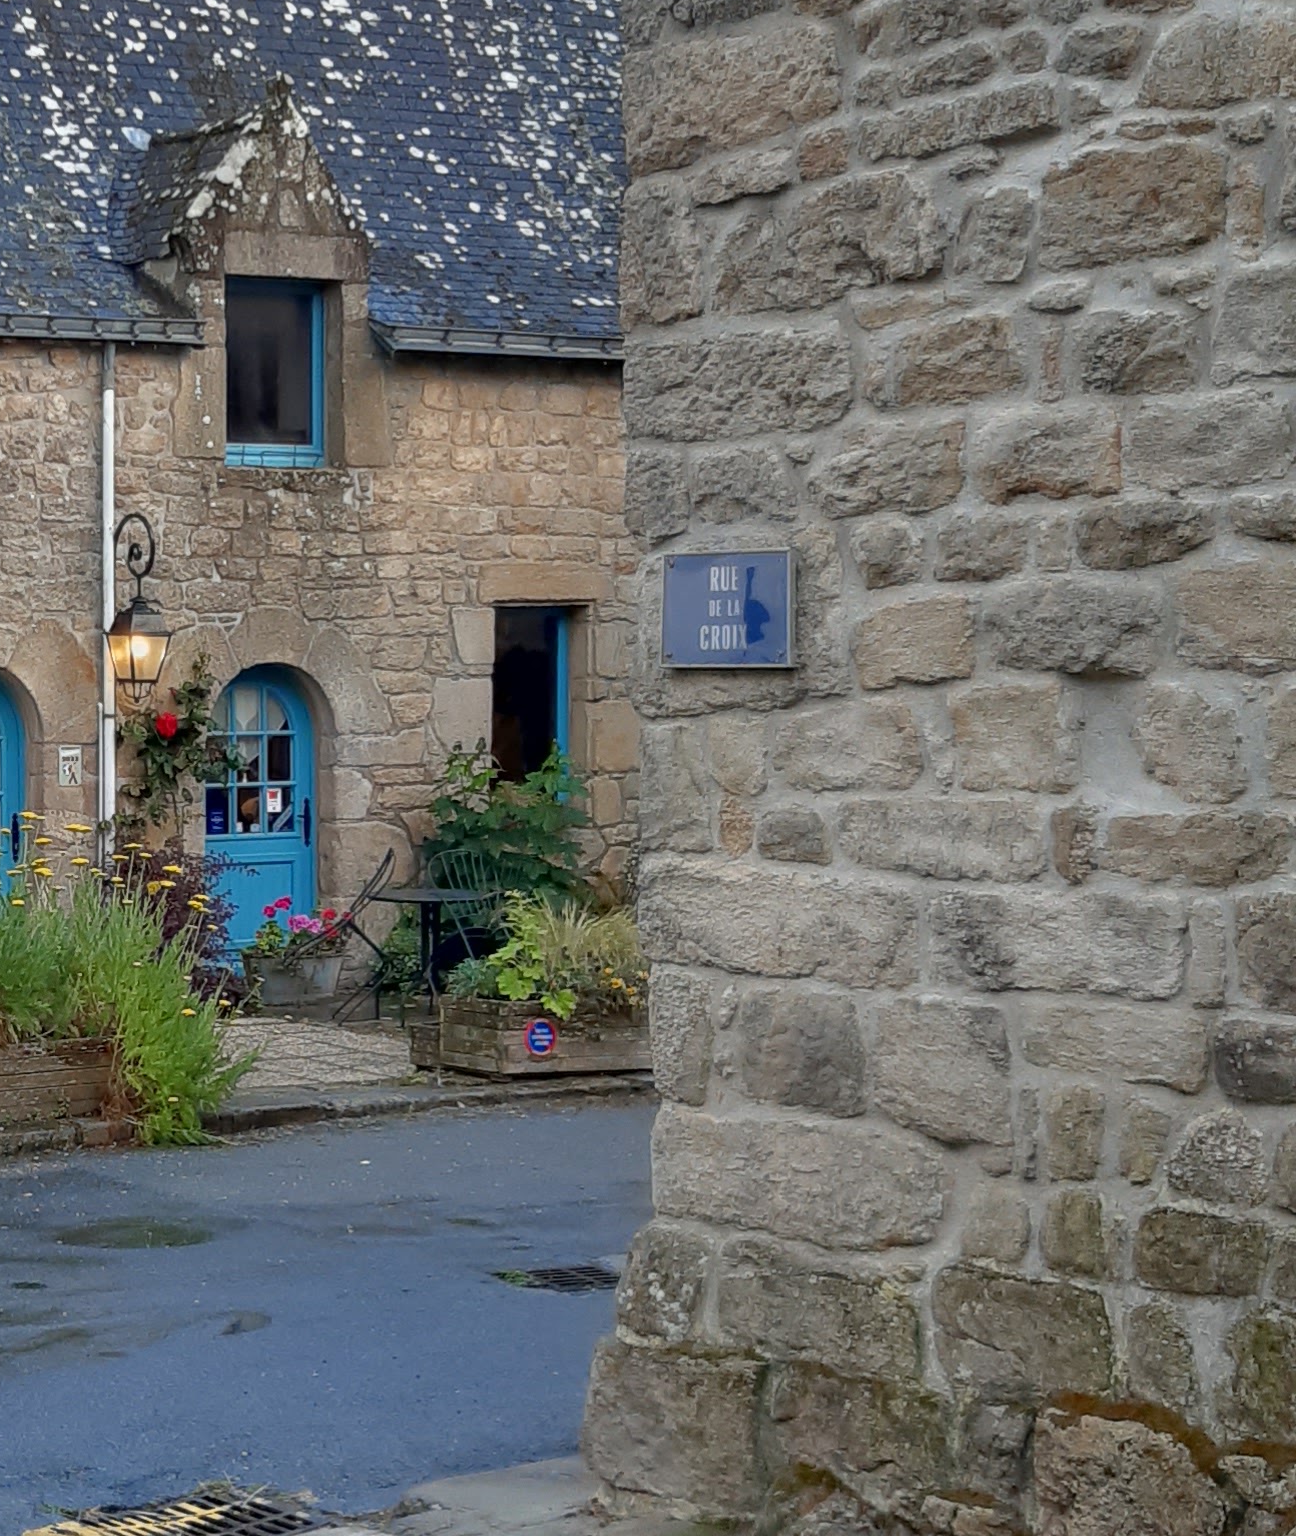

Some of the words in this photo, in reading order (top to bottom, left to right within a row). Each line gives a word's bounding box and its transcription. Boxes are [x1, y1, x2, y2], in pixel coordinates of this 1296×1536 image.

[709, 566, 738, 592] RUE
[708, 599, 721, 617] DE
[727, 599, 741, 617] LA
[699, 624, 747, 650] CROIX
